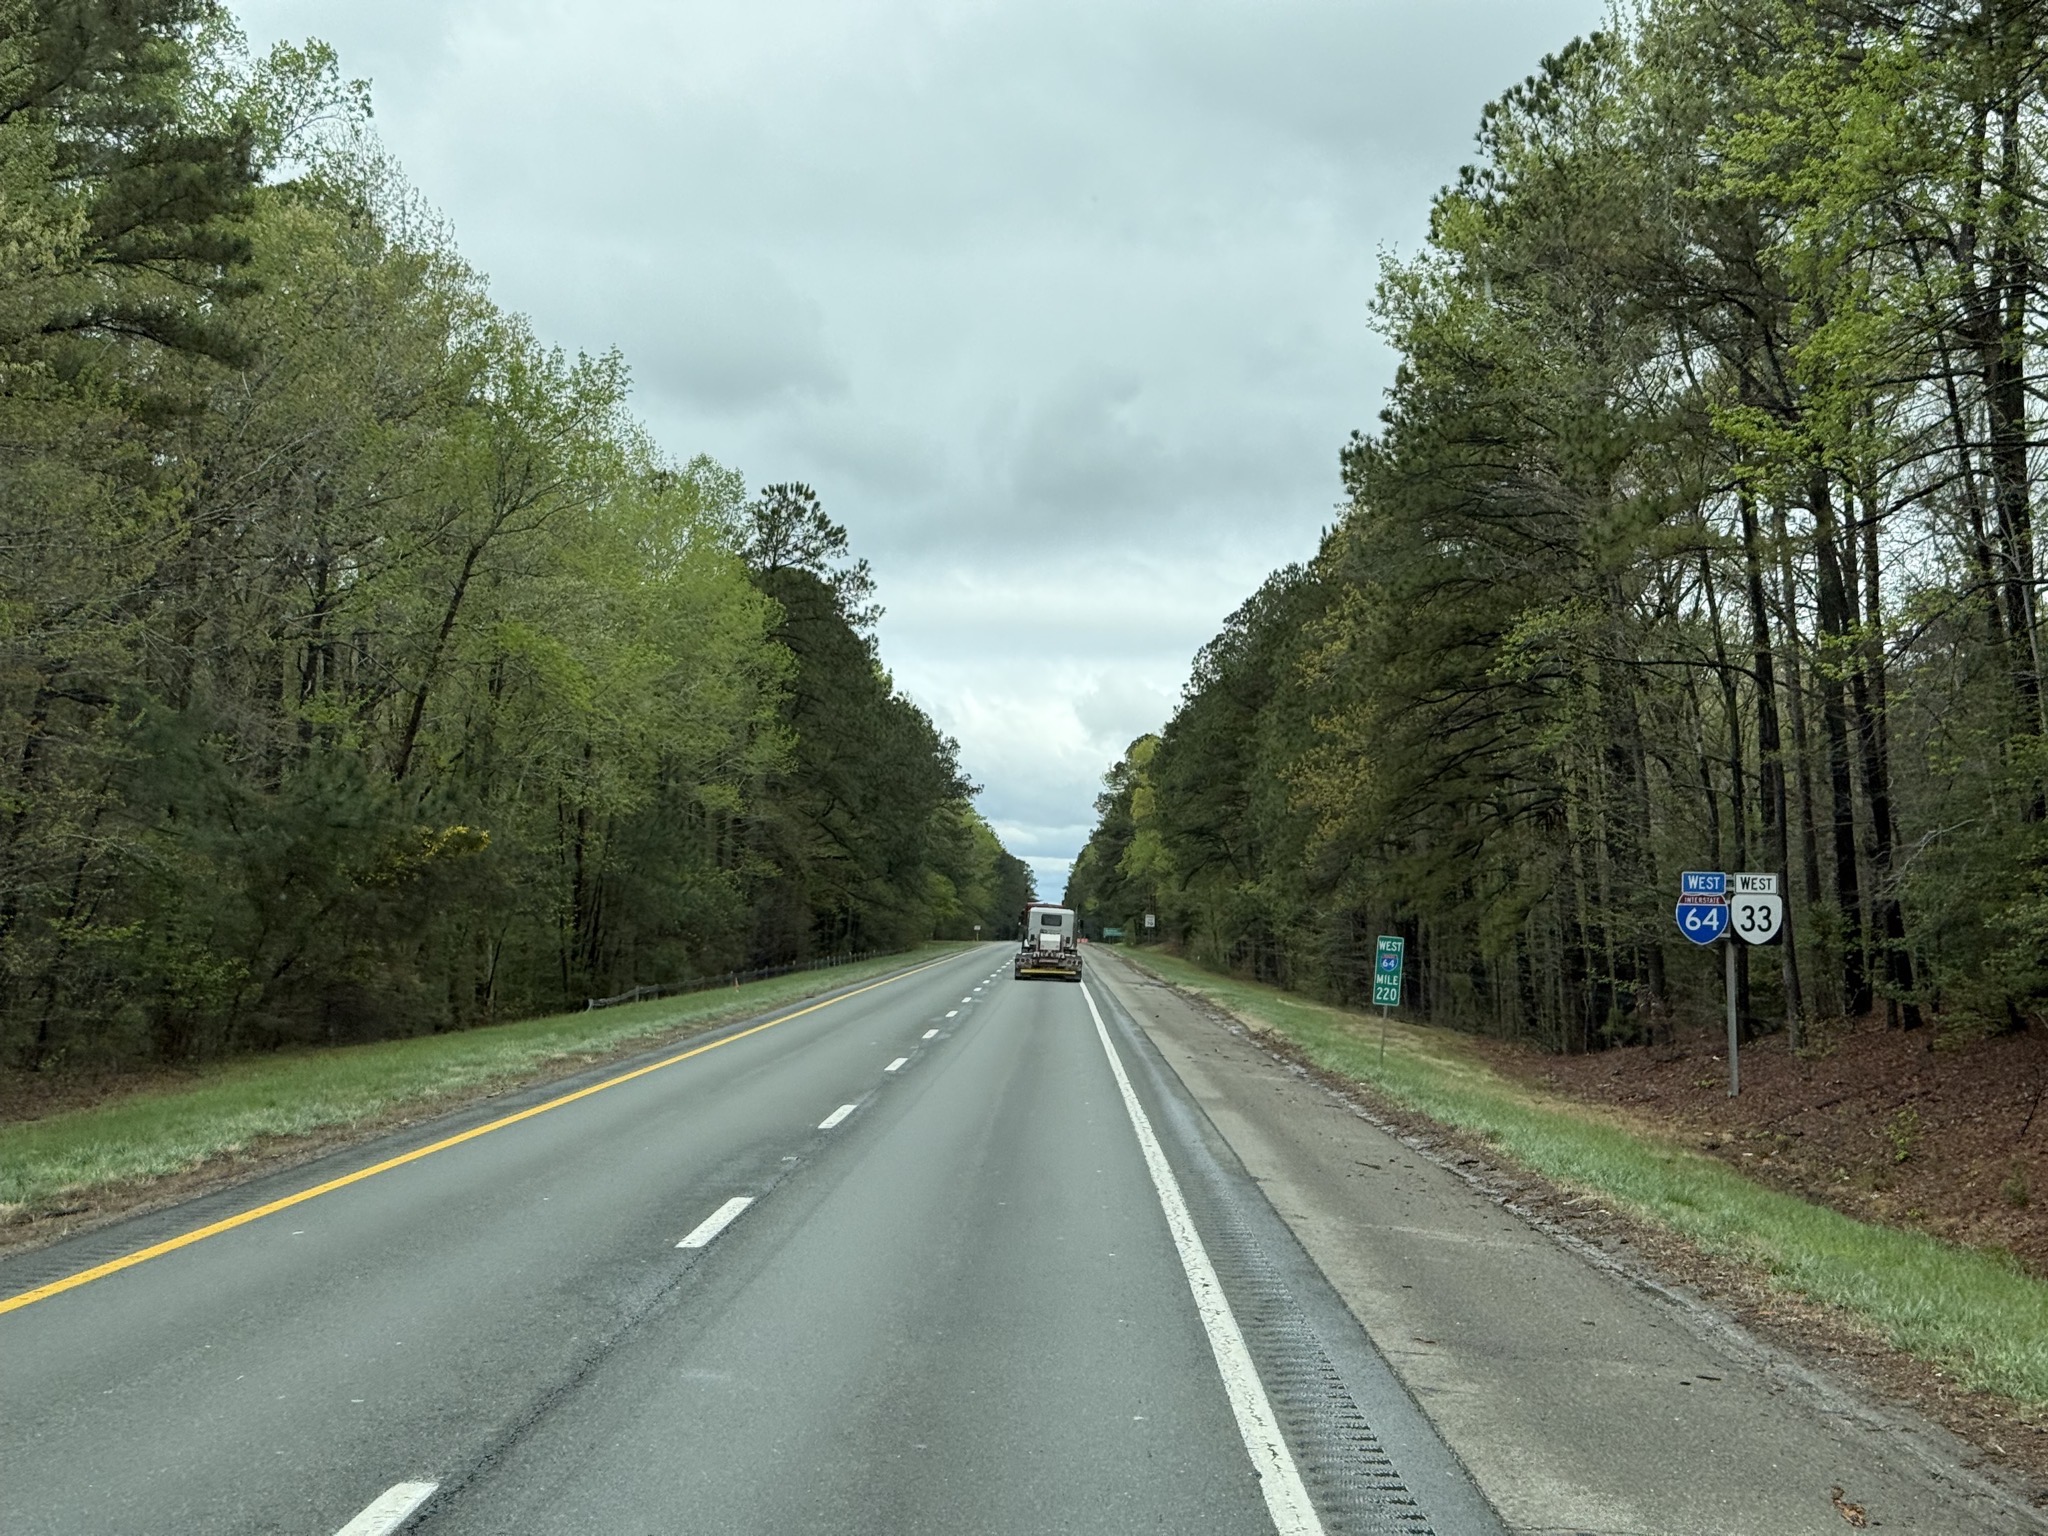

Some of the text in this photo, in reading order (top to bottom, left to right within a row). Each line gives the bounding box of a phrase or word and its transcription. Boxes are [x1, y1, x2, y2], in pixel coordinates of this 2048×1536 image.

[1688, 875, 1720, 889] WEST
[1740, 877, 1772, 890] WEST
[1685, 907, 1719, 931] 64
[1740, 905, 1772, 932] 33
[1379, 941, 1402, 952] WEST
[1382, 959, 1394, 967] 64
[1377, 974, 1398, 985] MILE
[1376, 987, 1397, 1001] 220
